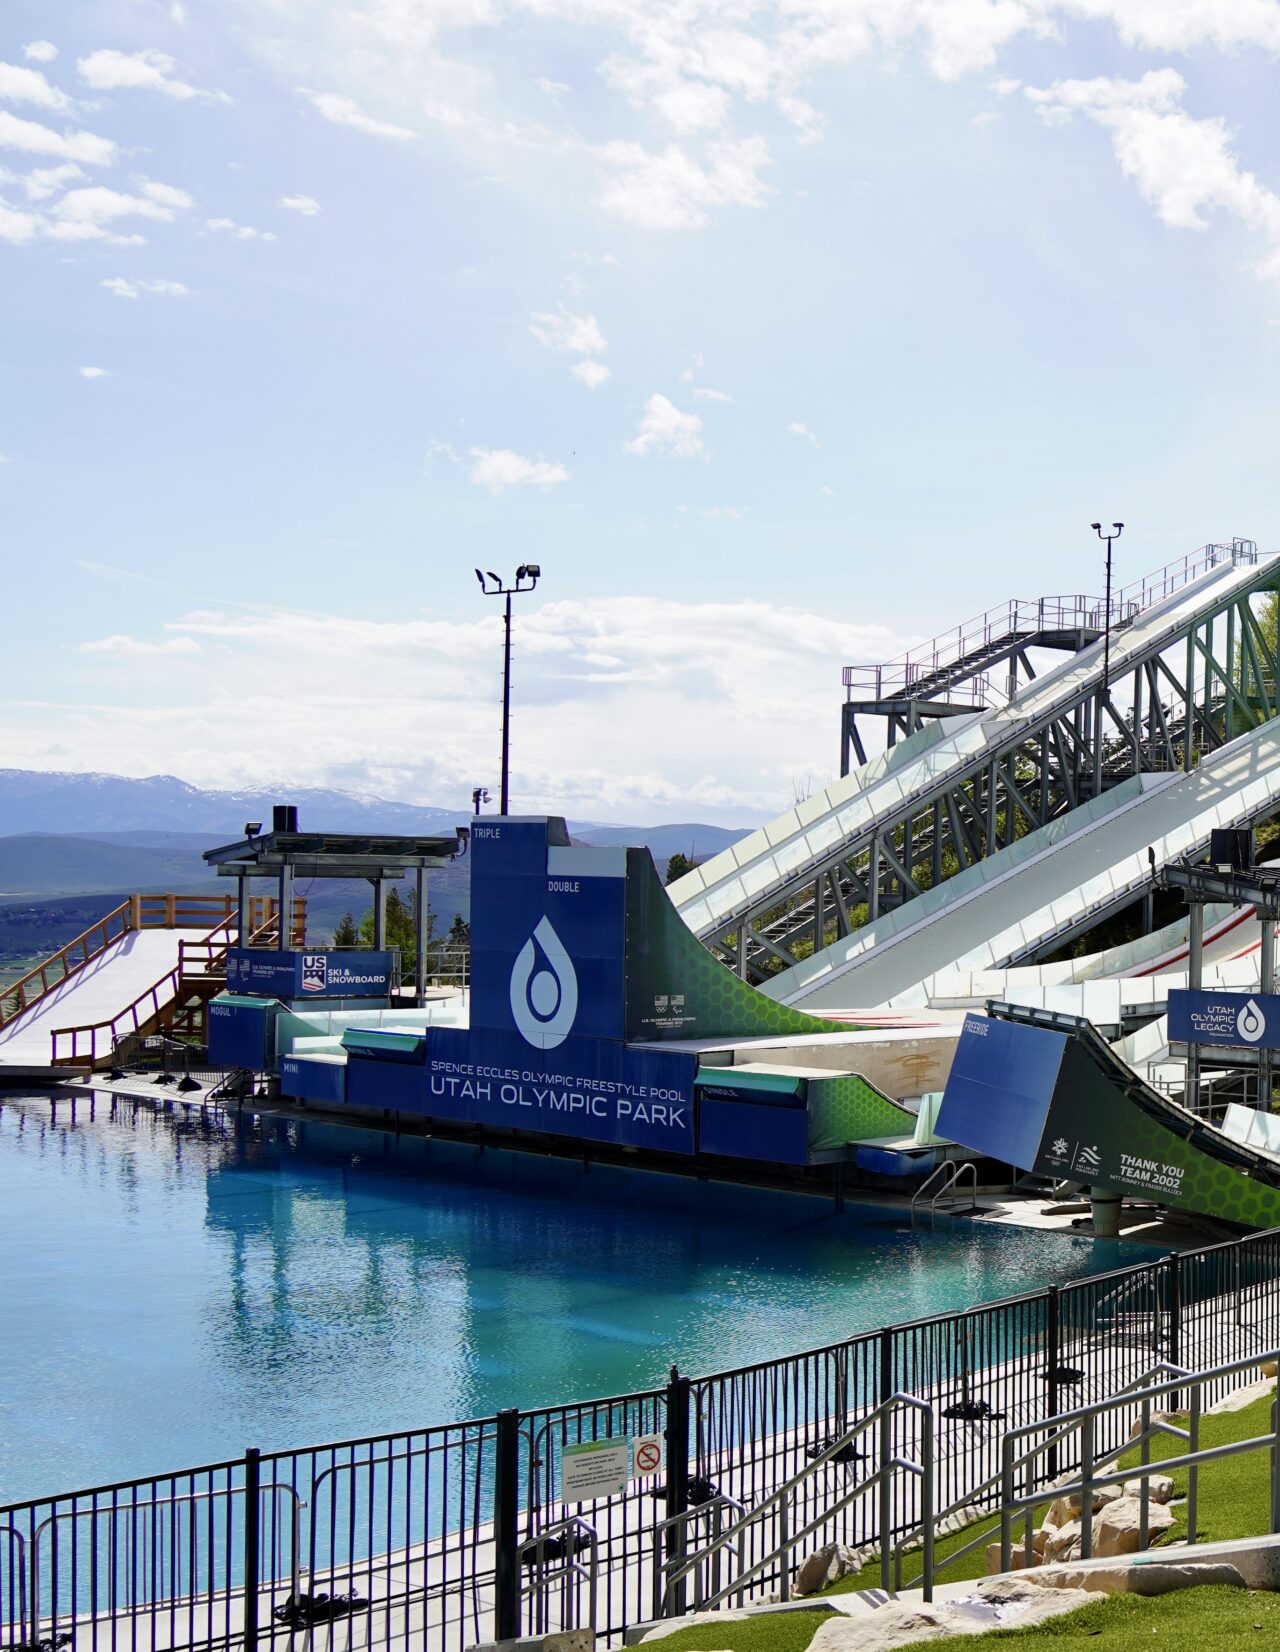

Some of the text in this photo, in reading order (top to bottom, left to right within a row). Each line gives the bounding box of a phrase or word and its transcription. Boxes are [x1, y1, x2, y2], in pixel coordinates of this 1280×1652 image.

[474, 828, 500, 838] TRIPLE
[548, 881, 580, 892] DOUBLE
[303, 957, 326, 969] US
[327, 975, 386, 984] SNOWBOARD
[210, 1005, 231, 1016] MOGUL
[1207, 1006, 1235, 1014] UTAH
[1190, 1013, 1235, 1023] OLYMPIC
[964, 1020, 990, 1036] FREERIDE
[1194, 1023, 1234, 1032] LEGACY
[283, 1062, 299, 1074] MINI
[431, 1061, 686, 1102] SPENCE ECCLES OLYMPIC FREESTYLE POOL
[431, 1075, 686, 1129] UTAH OLYMPIC PARK
[1120, 1154, 1184, 1178] THANK YOU
[1120, 1165, 1180, 1188] TEAM 2002
[1121, 1177, 1140, 1185] ROMNEY
[1145, 1182, 1162, 1191] FRASER
[1163, 1187, 1183, 1196] BULLOCK
